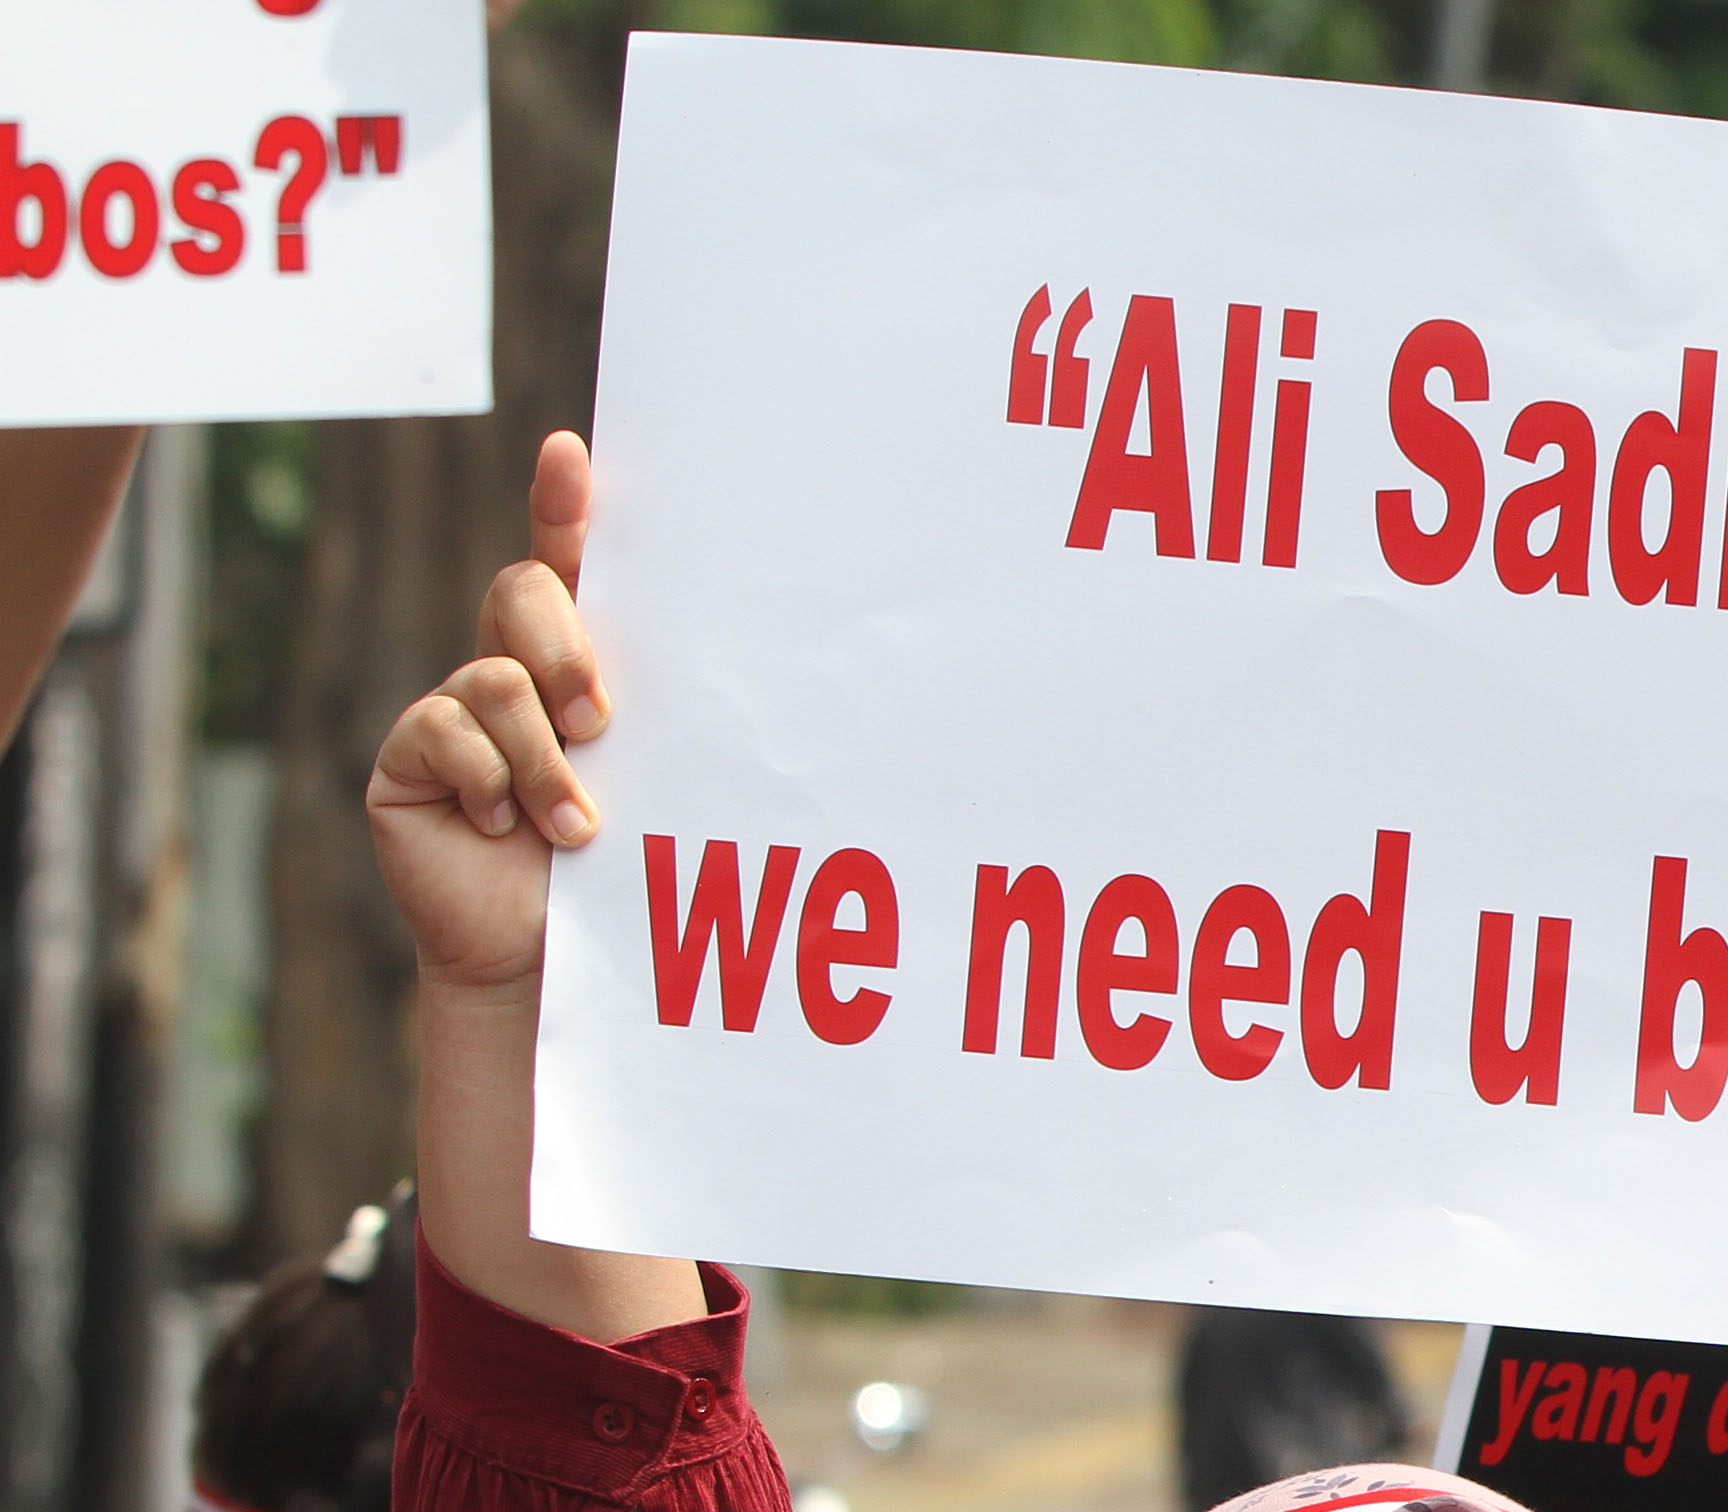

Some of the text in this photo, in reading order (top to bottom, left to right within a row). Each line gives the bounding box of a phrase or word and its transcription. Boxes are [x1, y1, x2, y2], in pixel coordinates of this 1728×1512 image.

[643, 834, 899, 1045] we
[962, 829, 1411, 1091] need
[1470, 911, 1572, 1106] u
[1479, 1358, 1691, 1477] yang
